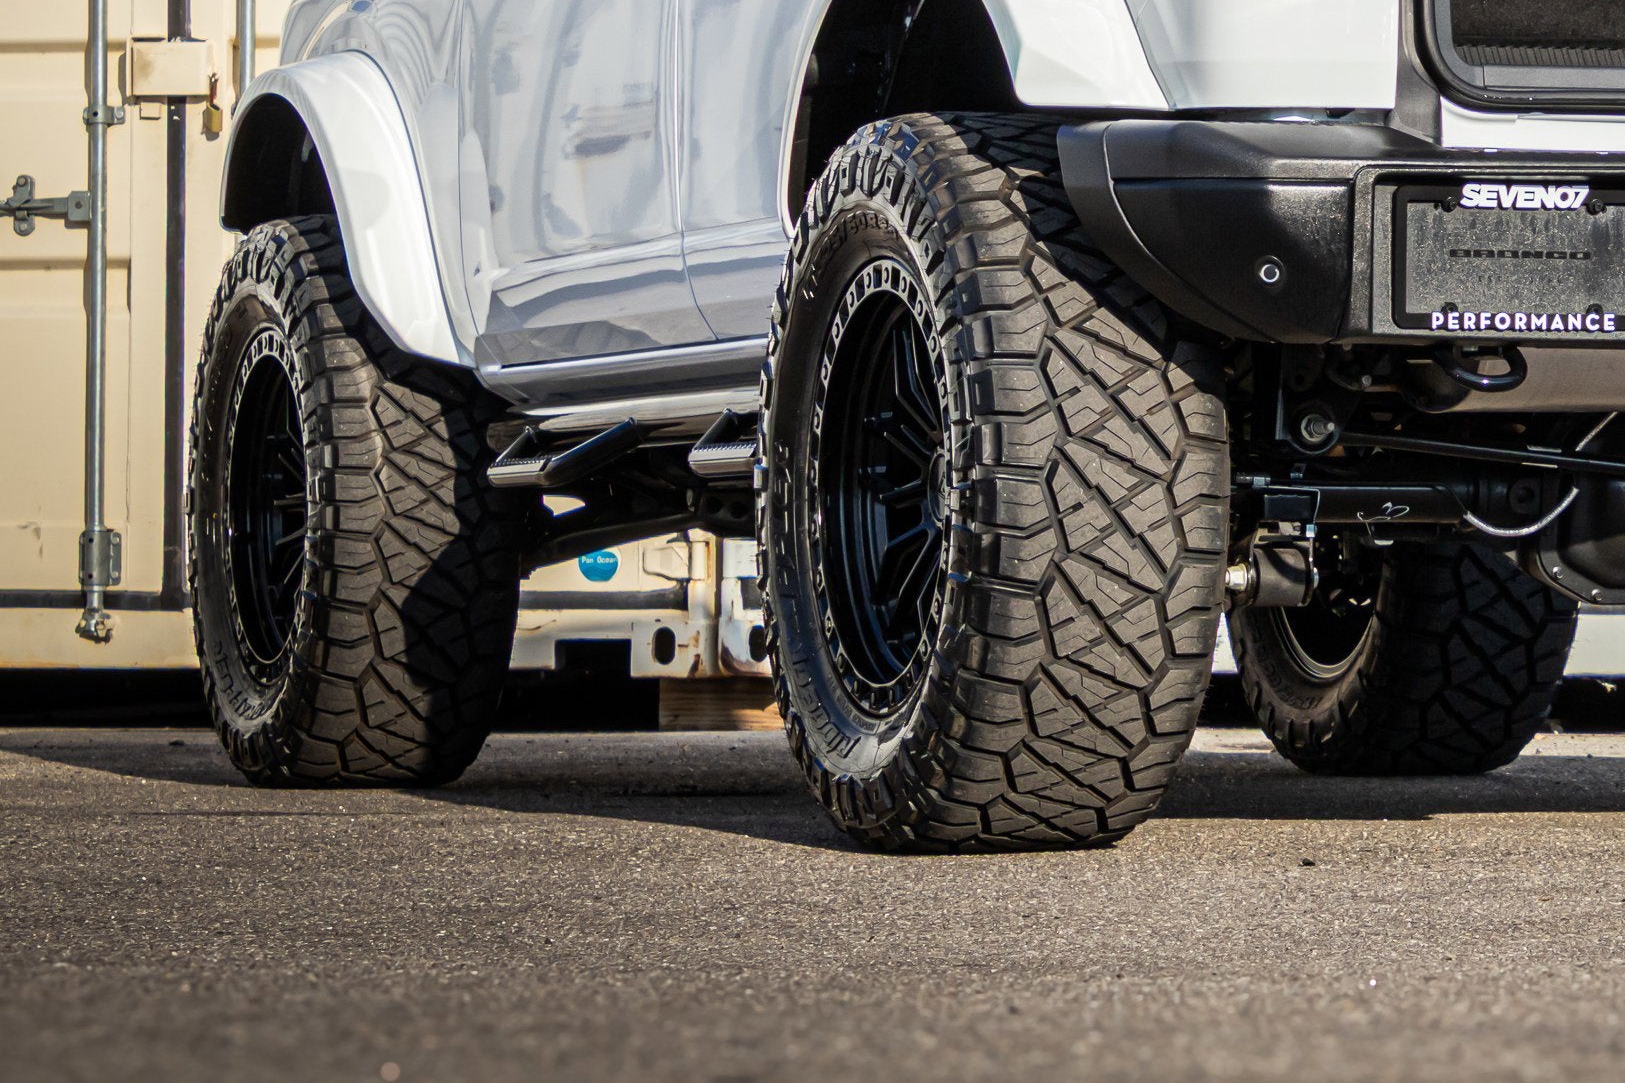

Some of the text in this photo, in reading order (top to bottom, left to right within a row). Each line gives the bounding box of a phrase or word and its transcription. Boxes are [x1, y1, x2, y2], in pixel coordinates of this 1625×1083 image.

[1450, 249, 1591, 260] BRONCO
[1431, 312, 1615, 332] PERFORMANCE
[581, 556, 594, 564] Pan
